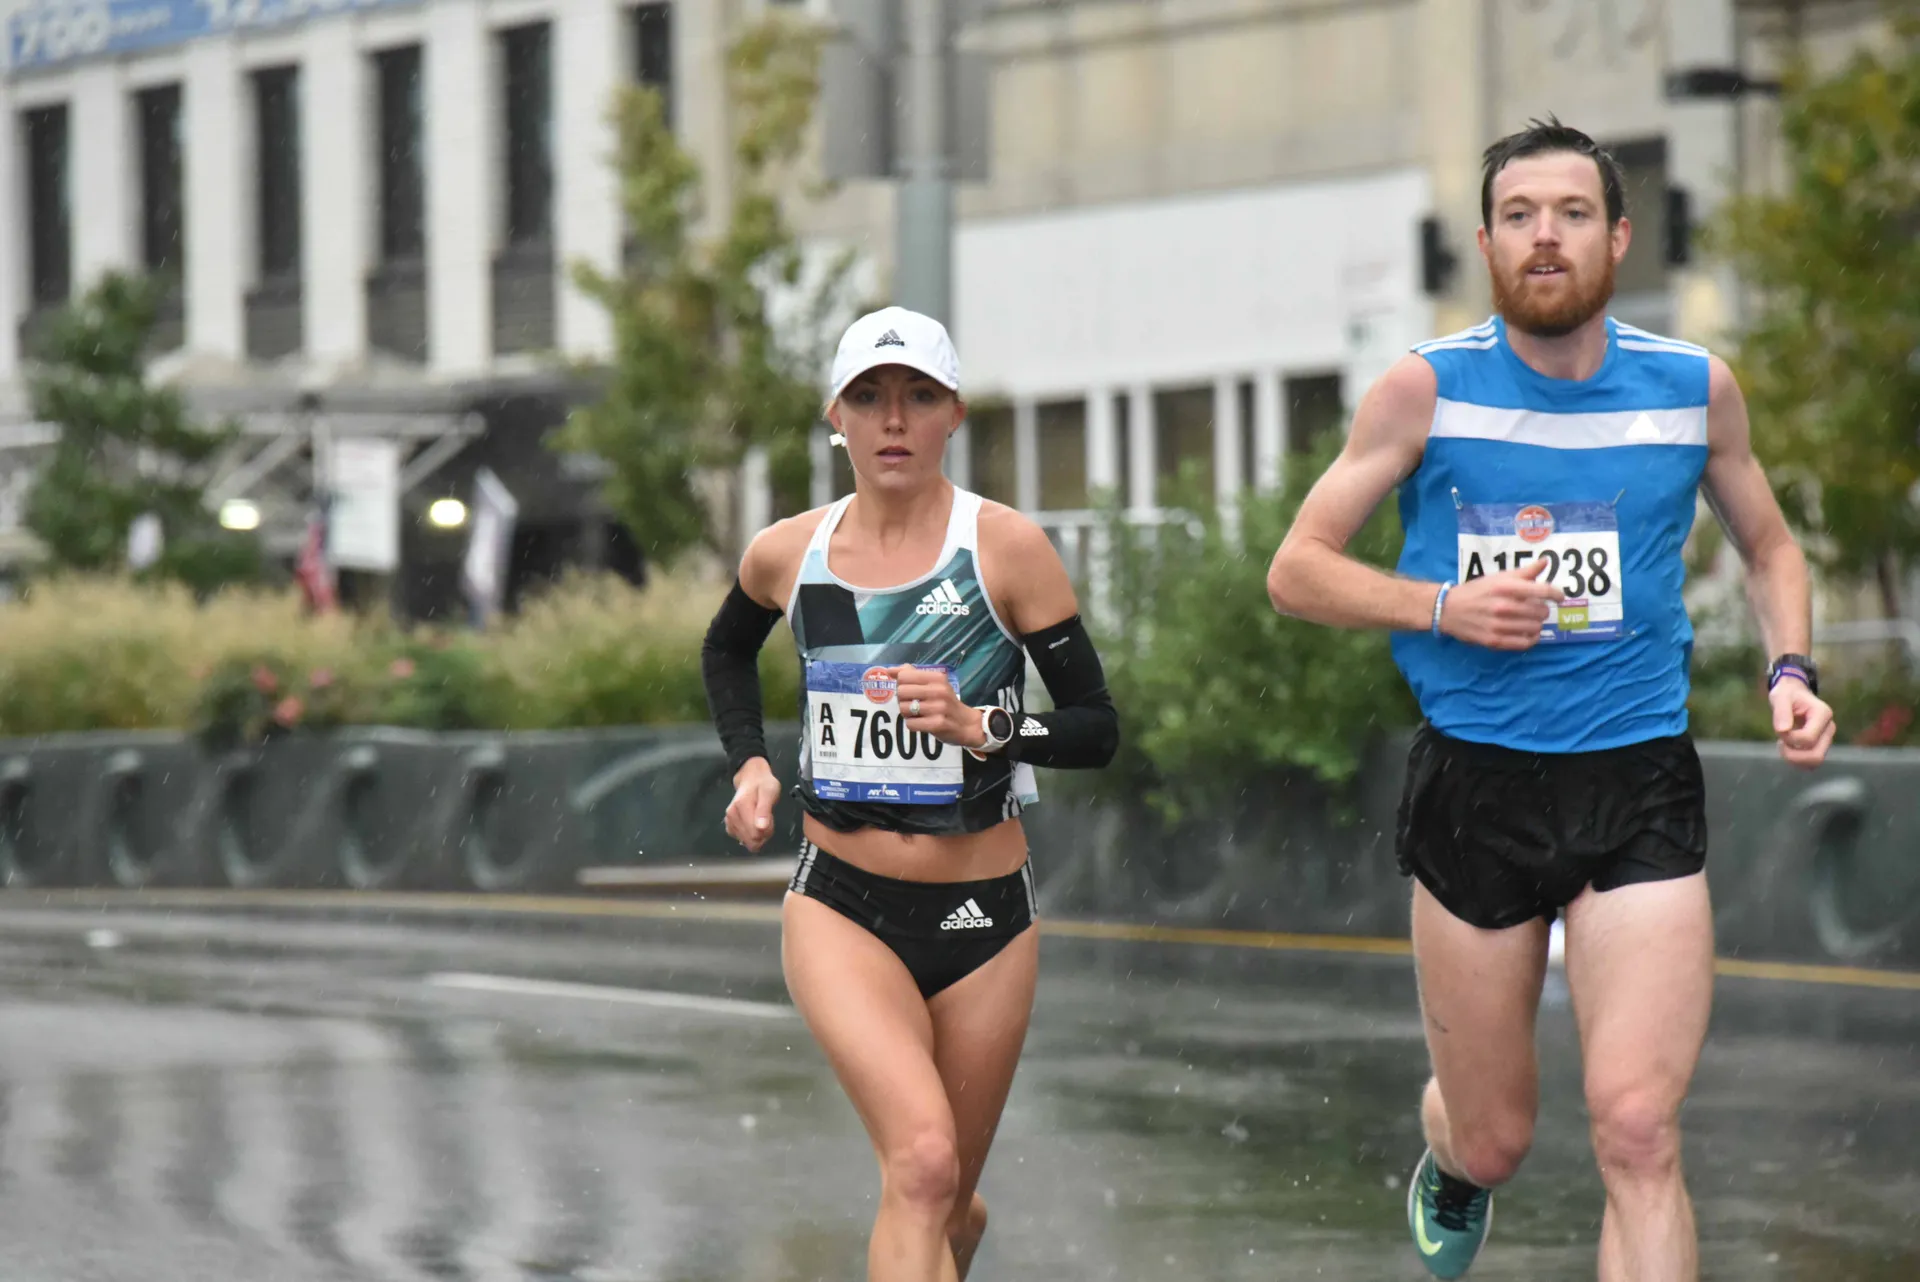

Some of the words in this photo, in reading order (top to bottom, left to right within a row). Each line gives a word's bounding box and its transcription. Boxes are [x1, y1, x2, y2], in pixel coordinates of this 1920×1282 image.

[916, 602, 970, 616] adidas
[1562, 613, 1585, 624] VIP
[1020, 726, 1049, 736] adidas
[940, 917, 993, 930] adidas
